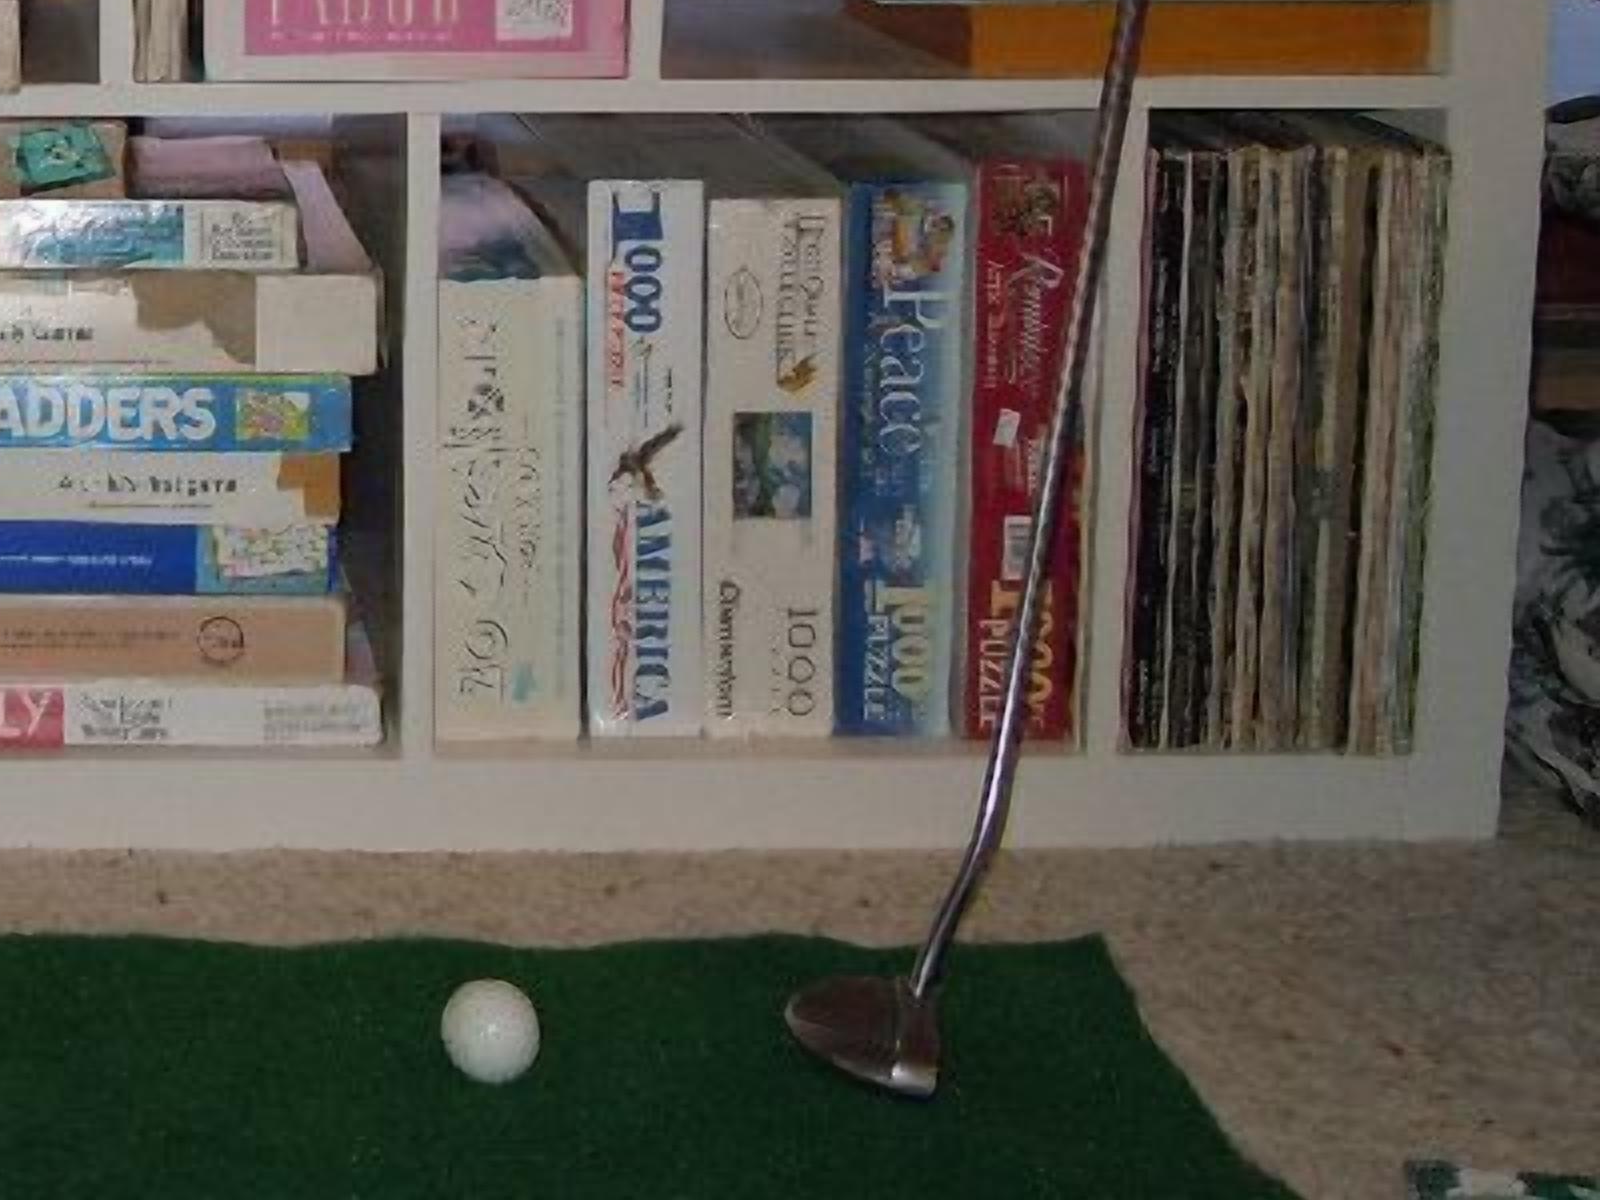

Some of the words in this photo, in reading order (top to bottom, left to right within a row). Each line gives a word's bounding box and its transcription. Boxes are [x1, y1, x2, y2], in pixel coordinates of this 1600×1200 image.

[880, 284, 953, 456] Peace
[635, 500, 671, 722] AMERICA
[787, 608, 818, 717] 1000
